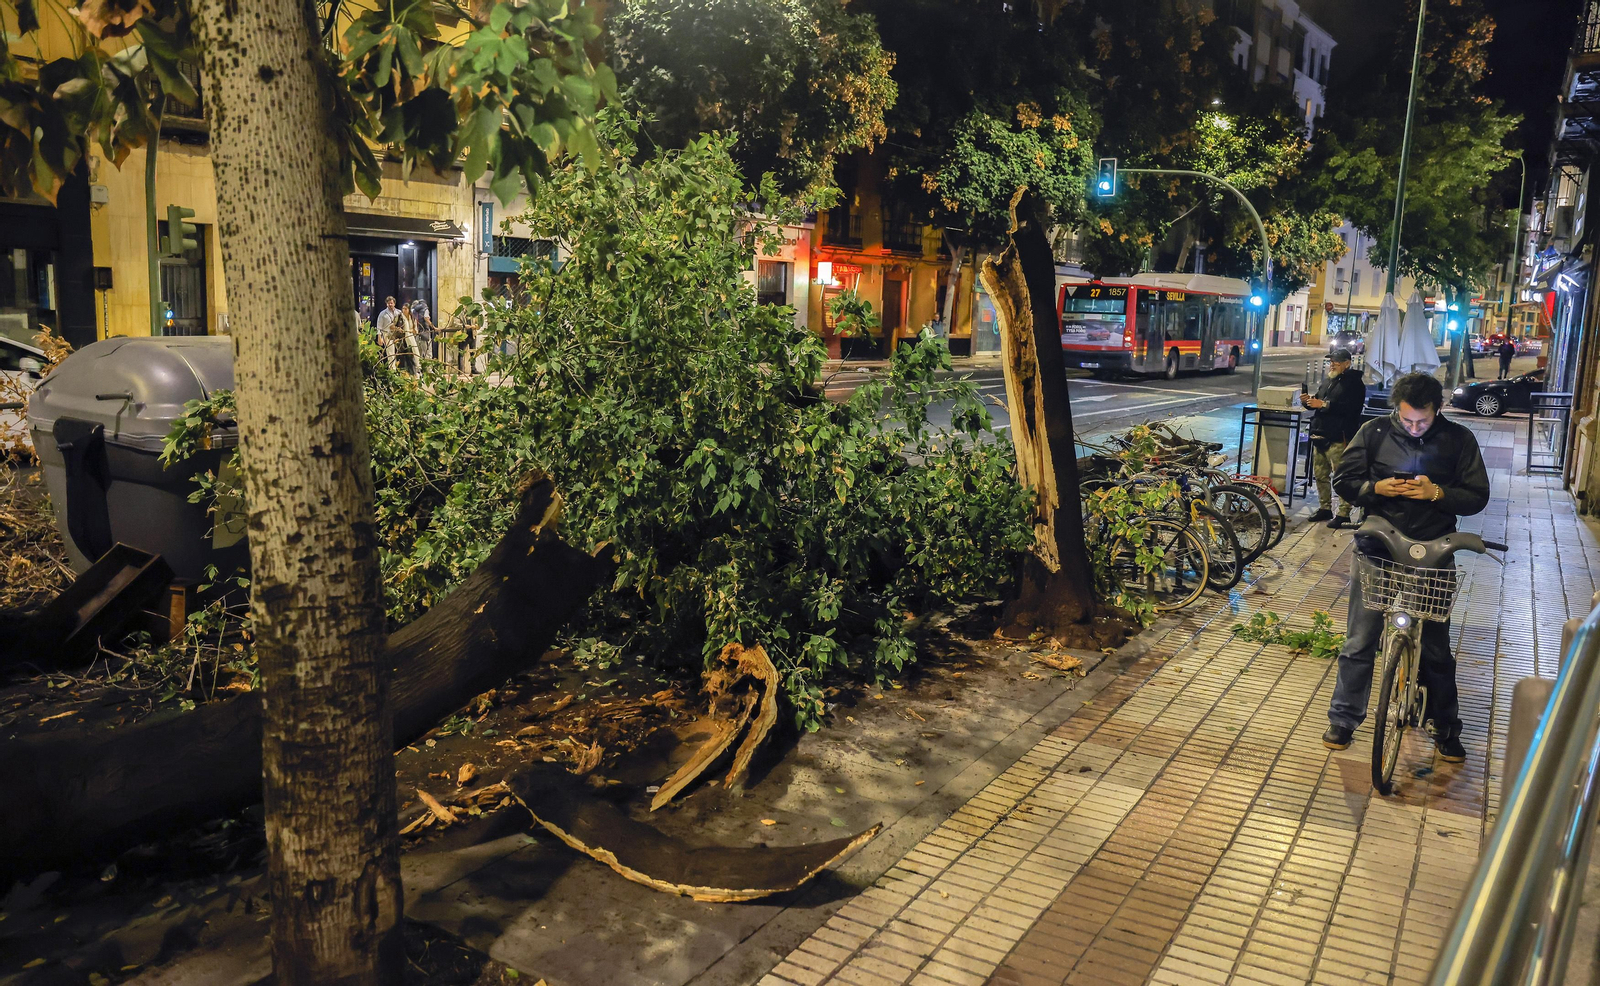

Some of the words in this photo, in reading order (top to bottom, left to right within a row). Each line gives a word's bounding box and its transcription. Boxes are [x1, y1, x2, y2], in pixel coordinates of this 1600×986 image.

[1090, 288, 1101, 298] 27
[1108, 287, 1127, 296] 1857
[1166, 291, 1186, 302] SEVILLA
